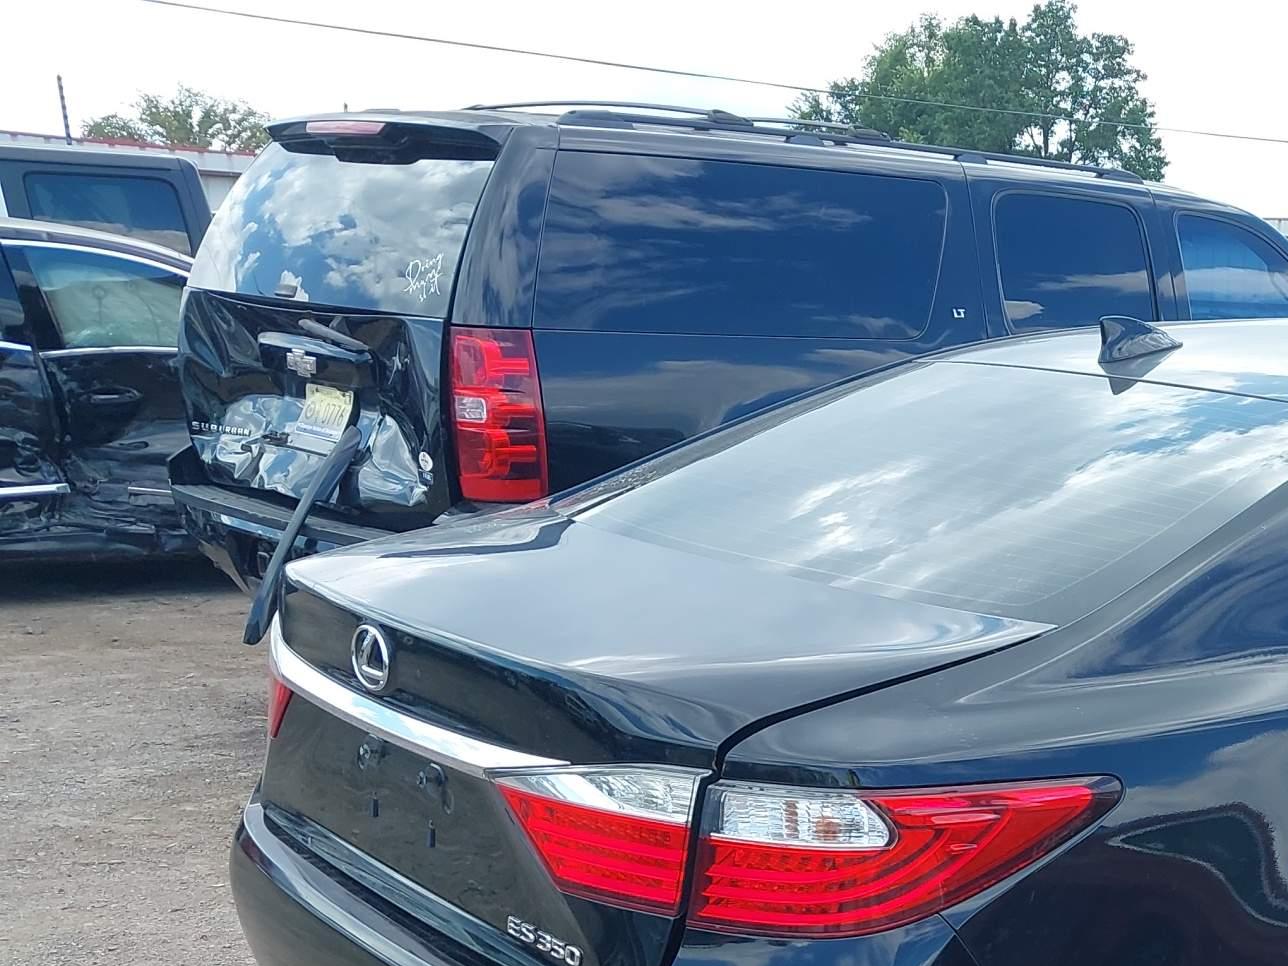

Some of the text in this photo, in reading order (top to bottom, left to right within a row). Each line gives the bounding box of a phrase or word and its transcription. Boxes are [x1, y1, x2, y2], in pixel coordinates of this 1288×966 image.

[952, 308, 966, 319] LT
[191, 421, 251, 436] SUBURBAN
[507, 915, 581, 966] ES 350
